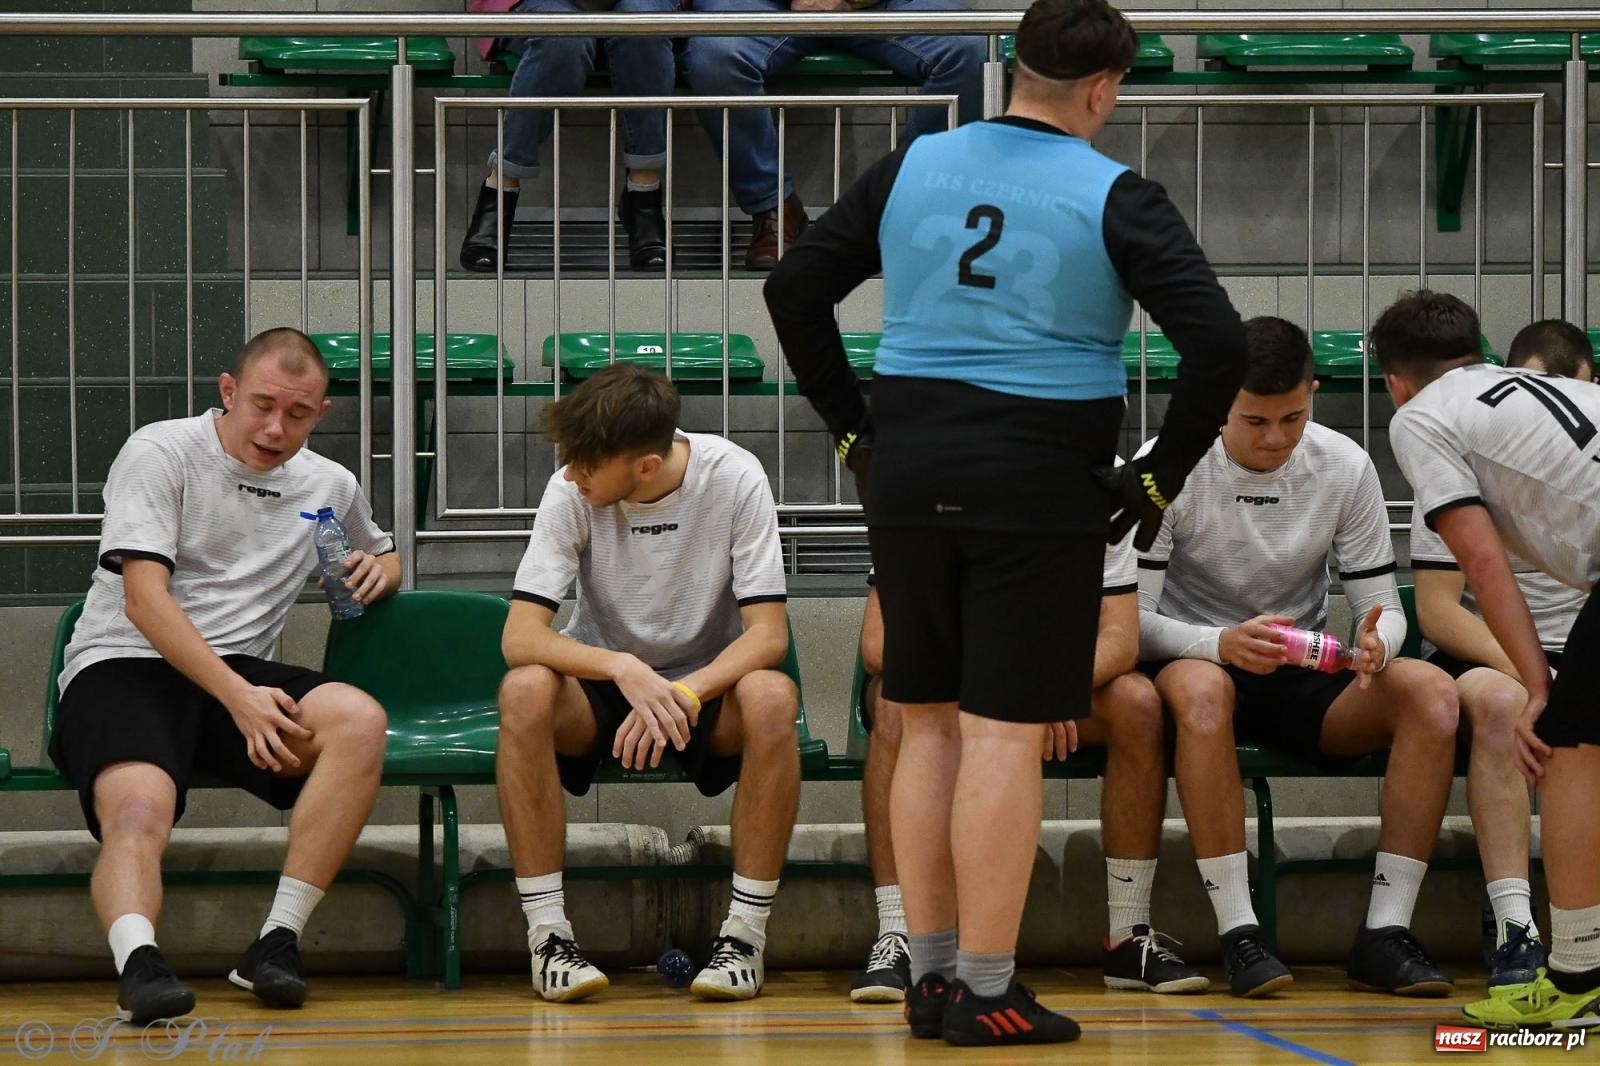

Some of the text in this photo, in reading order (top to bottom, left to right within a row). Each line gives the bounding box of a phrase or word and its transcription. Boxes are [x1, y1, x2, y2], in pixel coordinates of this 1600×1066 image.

[957, 203, 1005, 290] 2
[238, 483, 281, 498] regio
[1235, 495, 1280, 506] regio
[631, 522, 679, 536] regio
